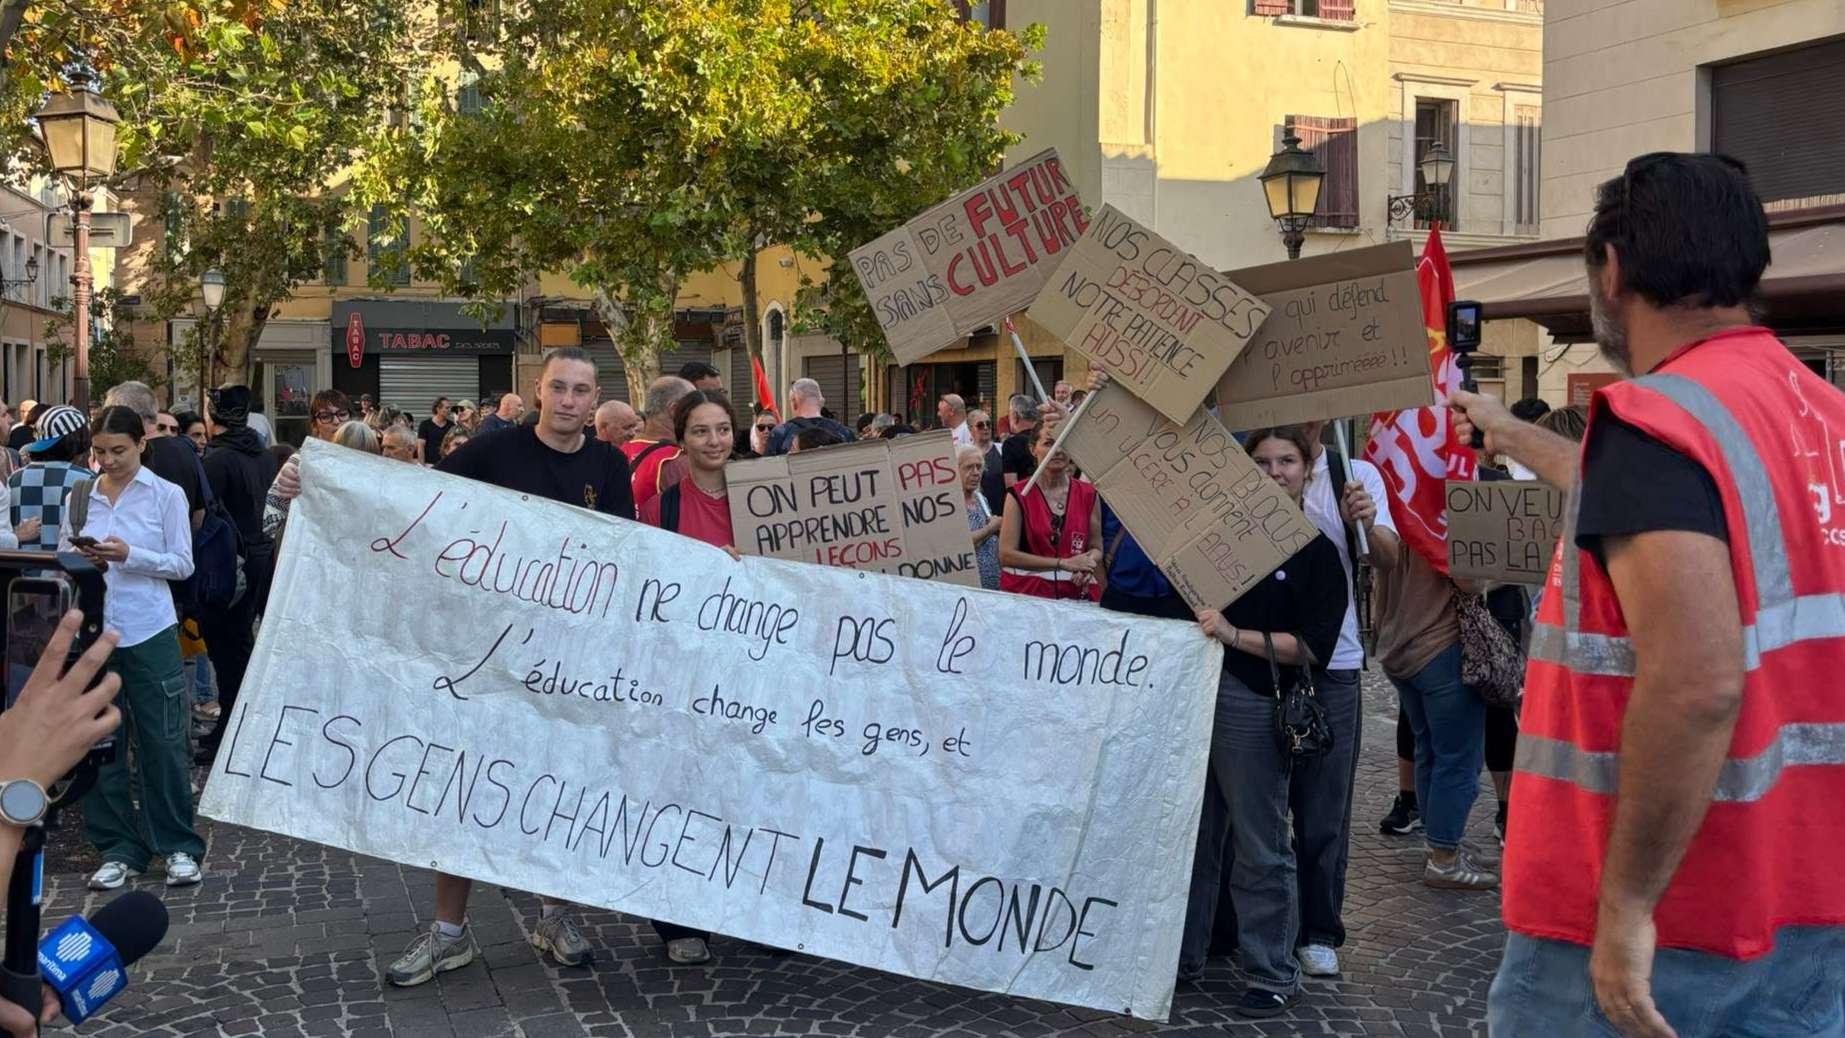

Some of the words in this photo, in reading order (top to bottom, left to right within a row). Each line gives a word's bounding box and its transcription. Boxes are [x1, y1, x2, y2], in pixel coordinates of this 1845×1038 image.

[856, 241, 913, 289] PAS
[918, 214, 964, 255] DE
[963, 157, 1071, 239] FUTUR
[876, 273, 952, 329] SANS
[947, 194, 1090, 296] CULTURE
[1090, 211, 1150, 262] NOS
[1142, 248, 1266, 340] CLASSES
[1060, 271, 1133, 332] NOTRE
[1123, 313, 1205, 378] PATIENCE
[1285, 291, 1316, 329] qui
[1328, 278, 1389, 320] défend
[1361, 316, 1381, 341] et
[351, 320, 361, 361] TABAC
[379, 333, 450, 349] TABAC
[1146, 415, 1195, 474] VOUS
[747, 482, 799, 517] ON
[810, 469, 880, 507] PEUT
[898, 456, 956, 490] PAS
[1189, 420, 1240, 470] NOS
[1230, 468, 1310, 556] BLOCUS
[1448, 487, 1492, 513] ON
[1499, 487, 1563, 519] VEU
[756, 505, 890, 555] APPRENDRE
[902, 492, 955, 528] NOS
[1452, 540, 1497, 568] PAS
[1507, 541, 1541, 569] LA
[370, 491, 618, 618] L'éducation
[635, 578, 681, 622] ne
[698, 576, 799, 661] change
[829, 615, 896, 676] pas
[936, 597, 976, 674] le
[1024, 629, 1155, 689] monde.
[433, 623, 663, 707] L'éducation
[692, 684, 778, 737] change
[802, 699, 845, 738] les
[862, 722, 929, 757] gens,
[943, 726, 971, 757] et
[224, 702, 362, 788] LES
[365, 735, 515, 829] GENS
[519, 774, 801, 896] CHANGENT
[802, 836, 887, 922] LE
[891, 846, 1118, 971] MONDE
